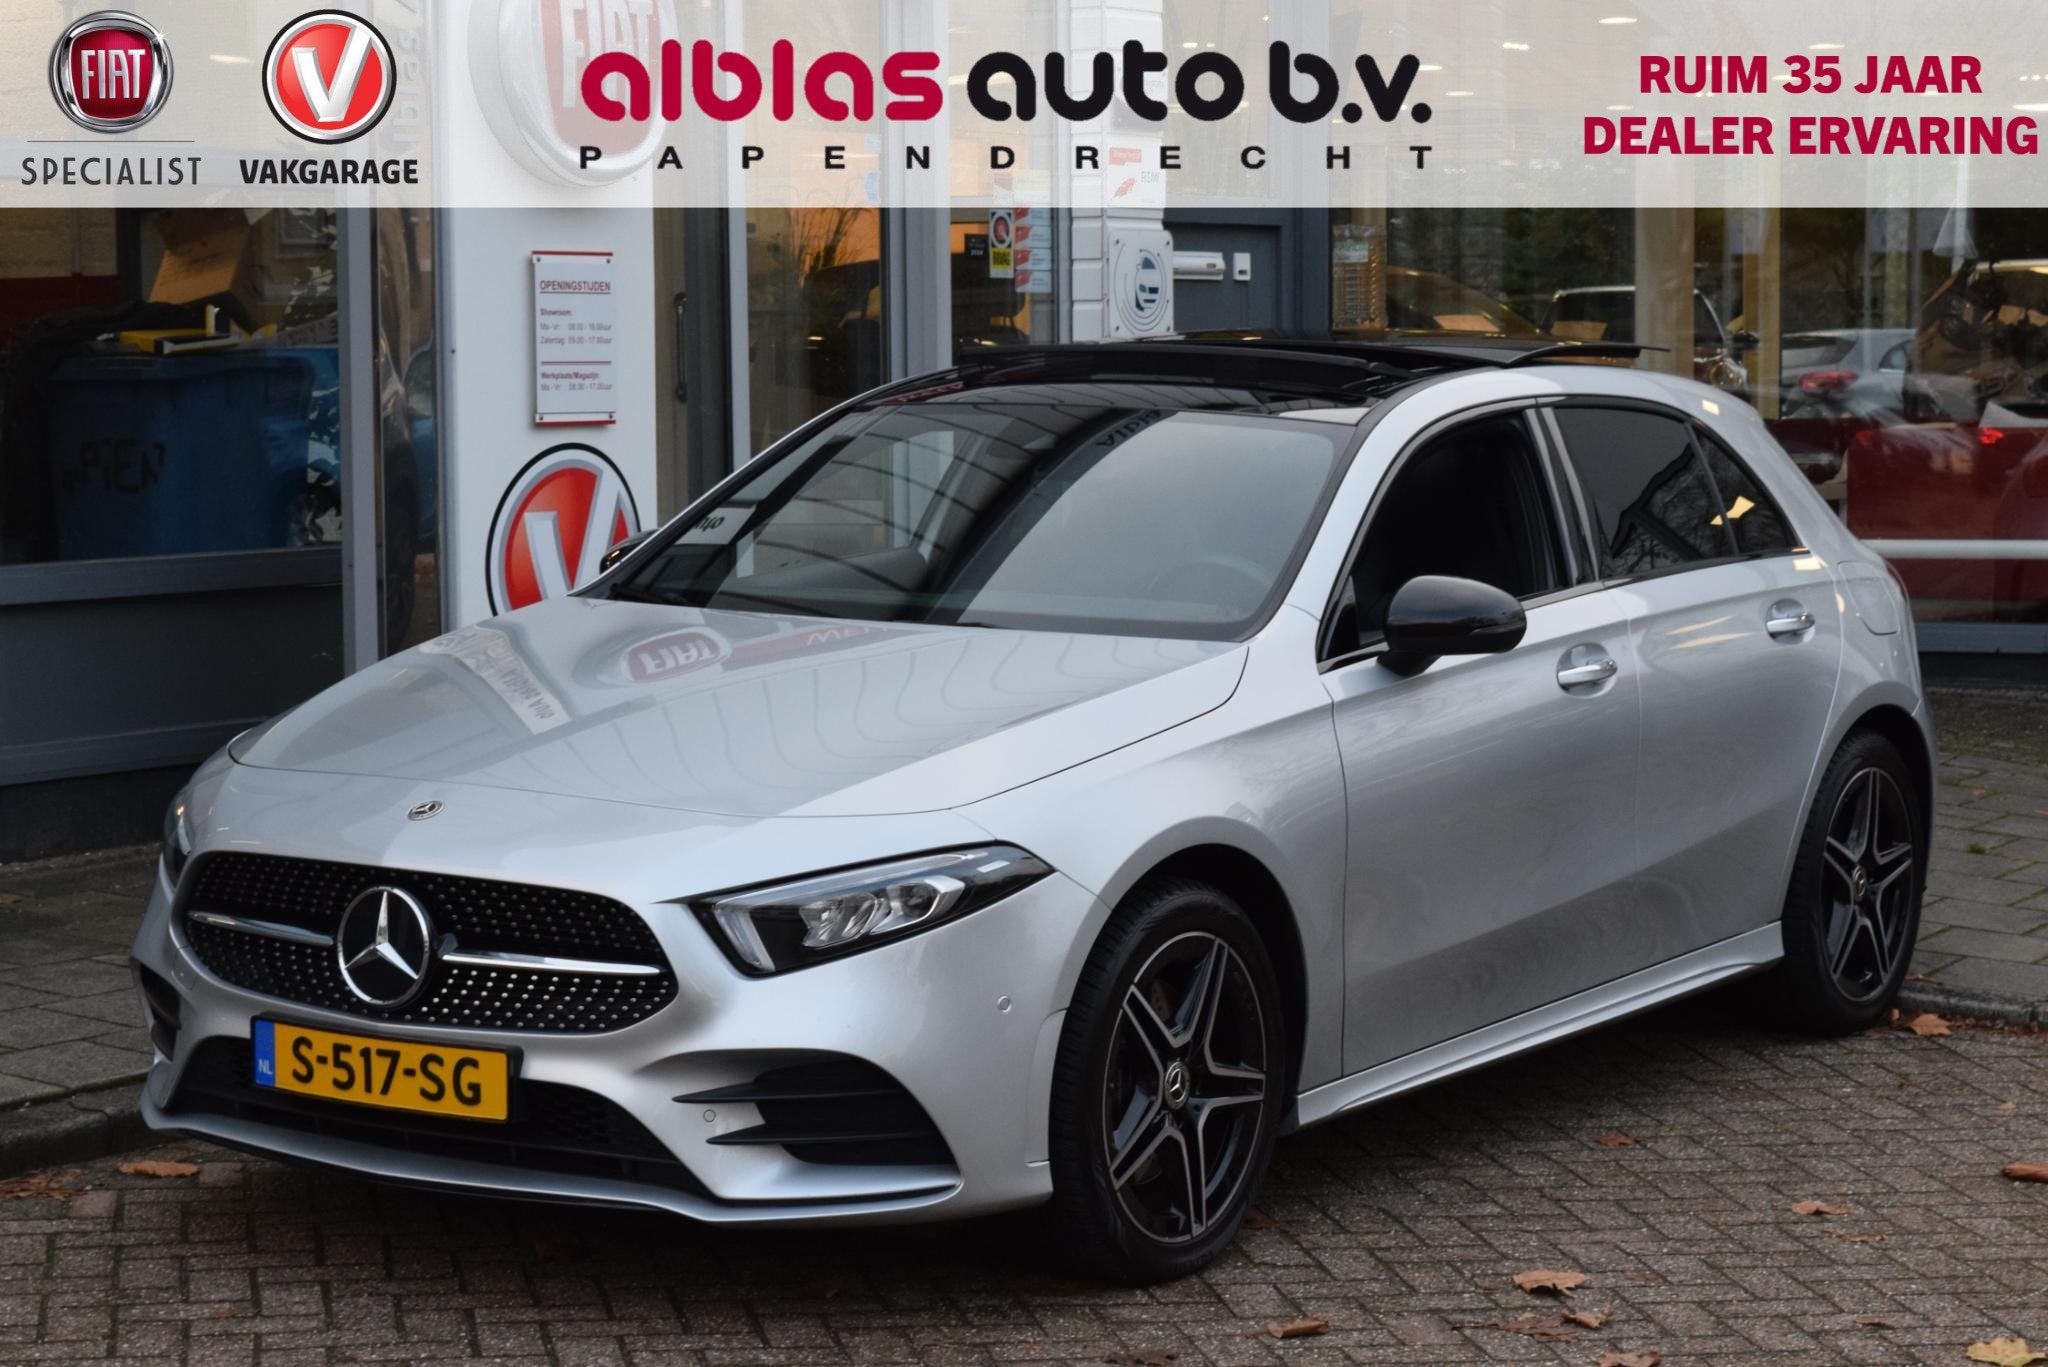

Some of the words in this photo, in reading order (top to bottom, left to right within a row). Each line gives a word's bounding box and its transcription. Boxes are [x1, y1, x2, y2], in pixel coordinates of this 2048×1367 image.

[539, 280, 611, 292] OPENINGSTIJDEN
[258, 1058, 273, 1075] NL
[291, 1035, 482, 1107] S-517-SG
